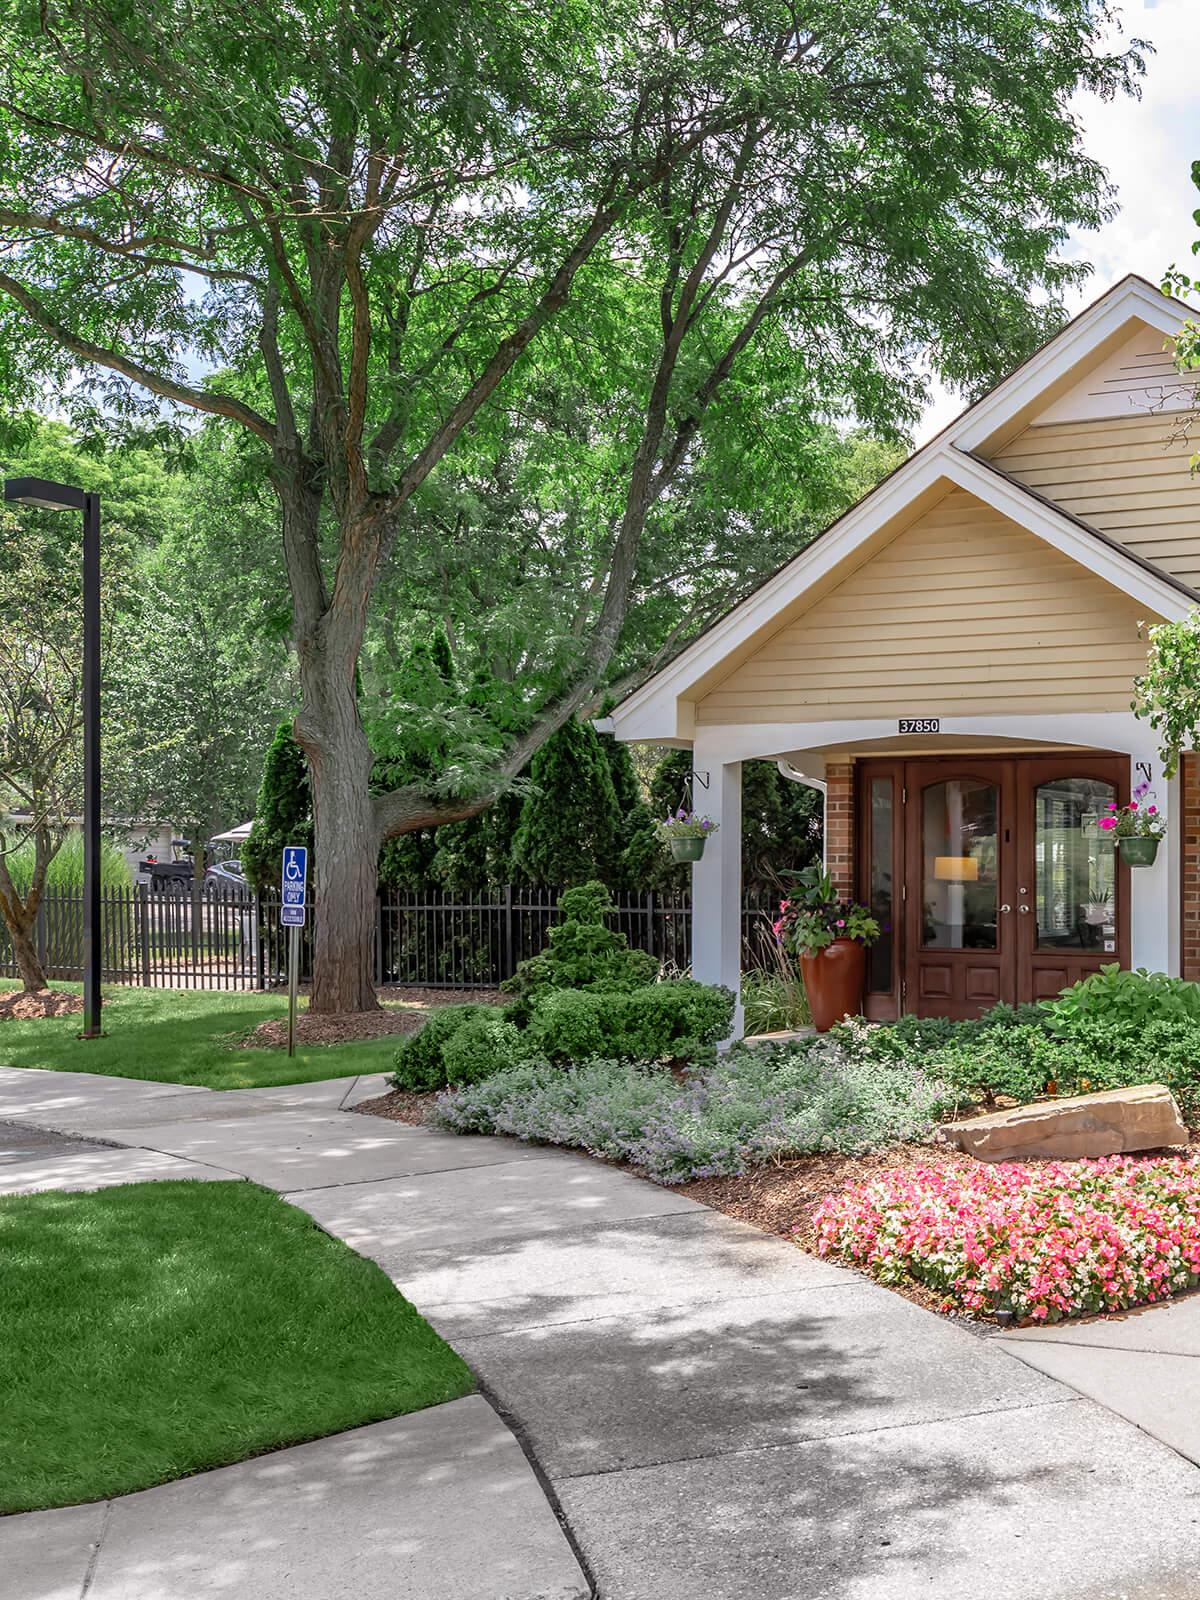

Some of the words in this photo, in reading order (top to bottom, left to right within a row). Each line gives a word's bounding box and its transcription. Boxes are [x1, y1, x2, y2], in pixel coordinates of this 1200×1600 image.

[900, 720, 938, 732] 37850
[284, 881, 304, 892] PARKING
[287, 891, 300, 903] ONLY
